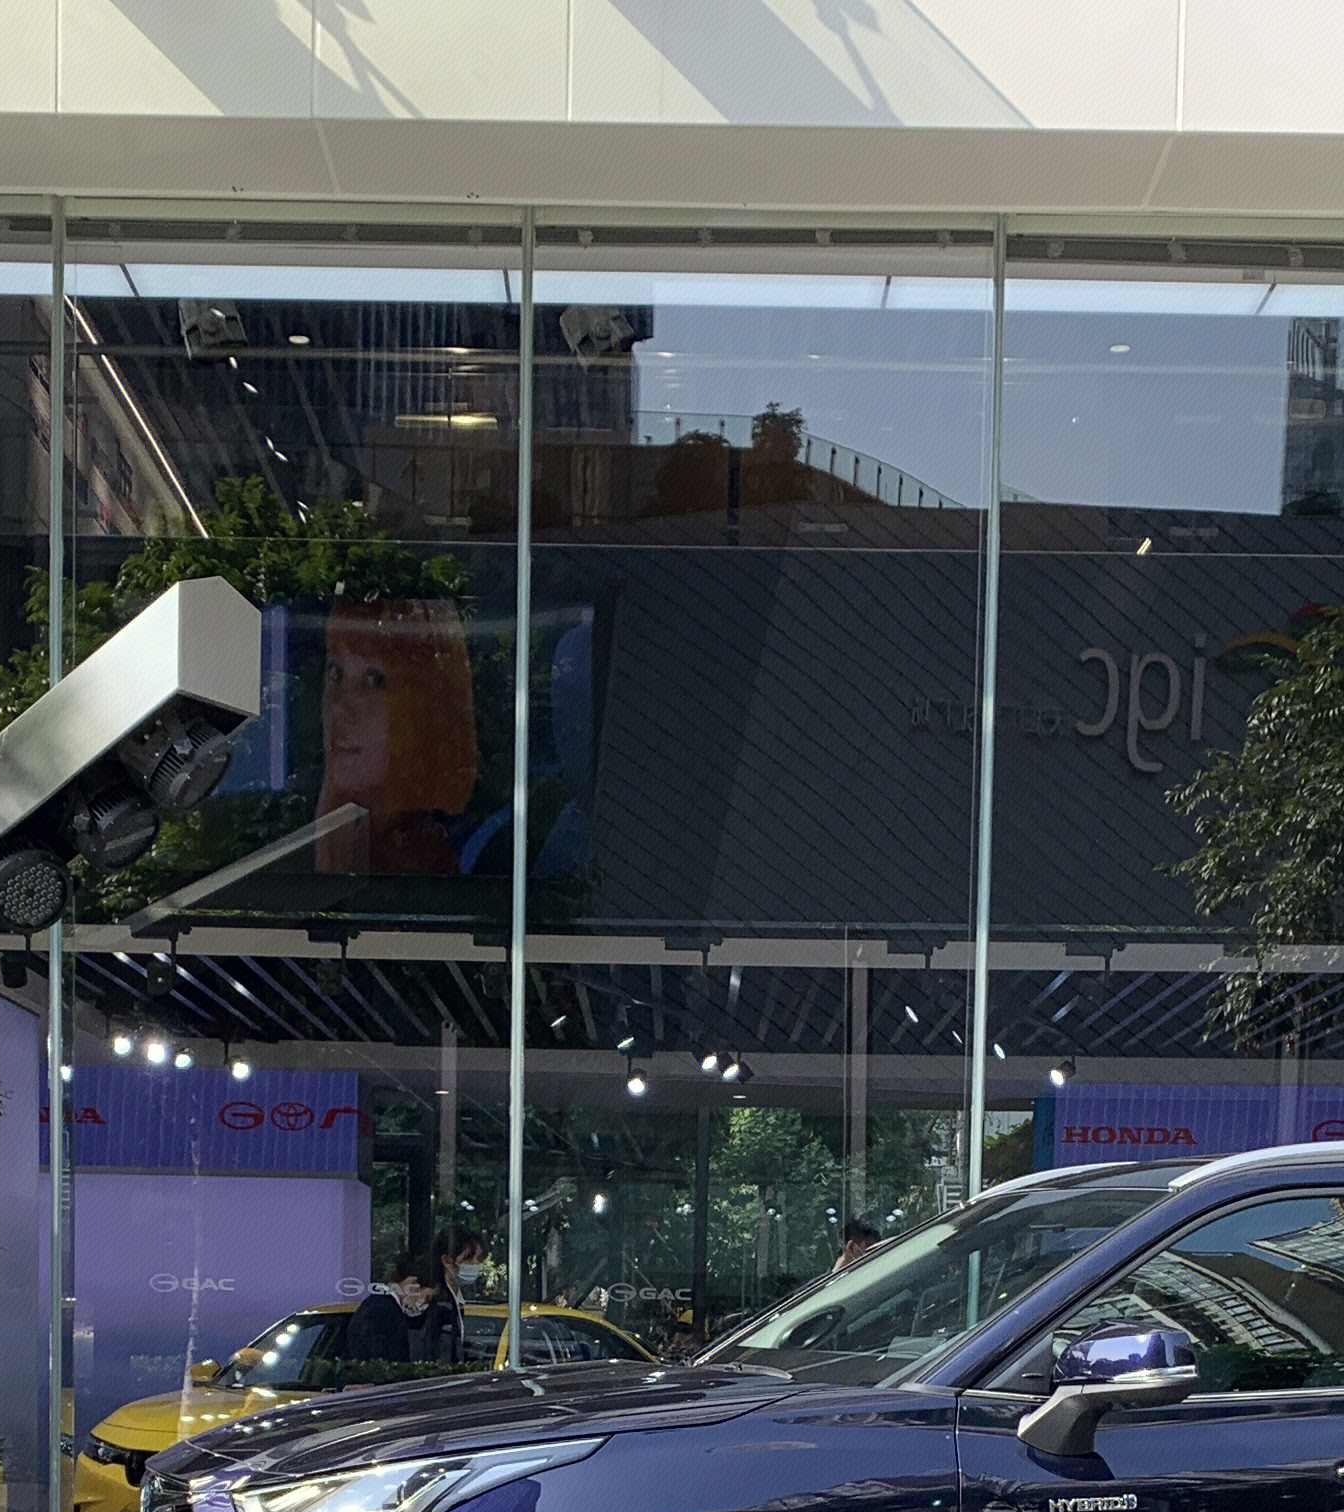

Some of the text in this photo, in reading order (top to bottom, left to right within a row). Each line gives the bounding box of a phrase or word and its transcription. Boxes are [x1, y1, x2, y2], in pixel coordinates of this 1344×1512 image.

[1062, 1126, 1197, 1146] HONDA
[181, 1278, 235, 1291] GAC
[639, 1287, 692, 1301] GAC
